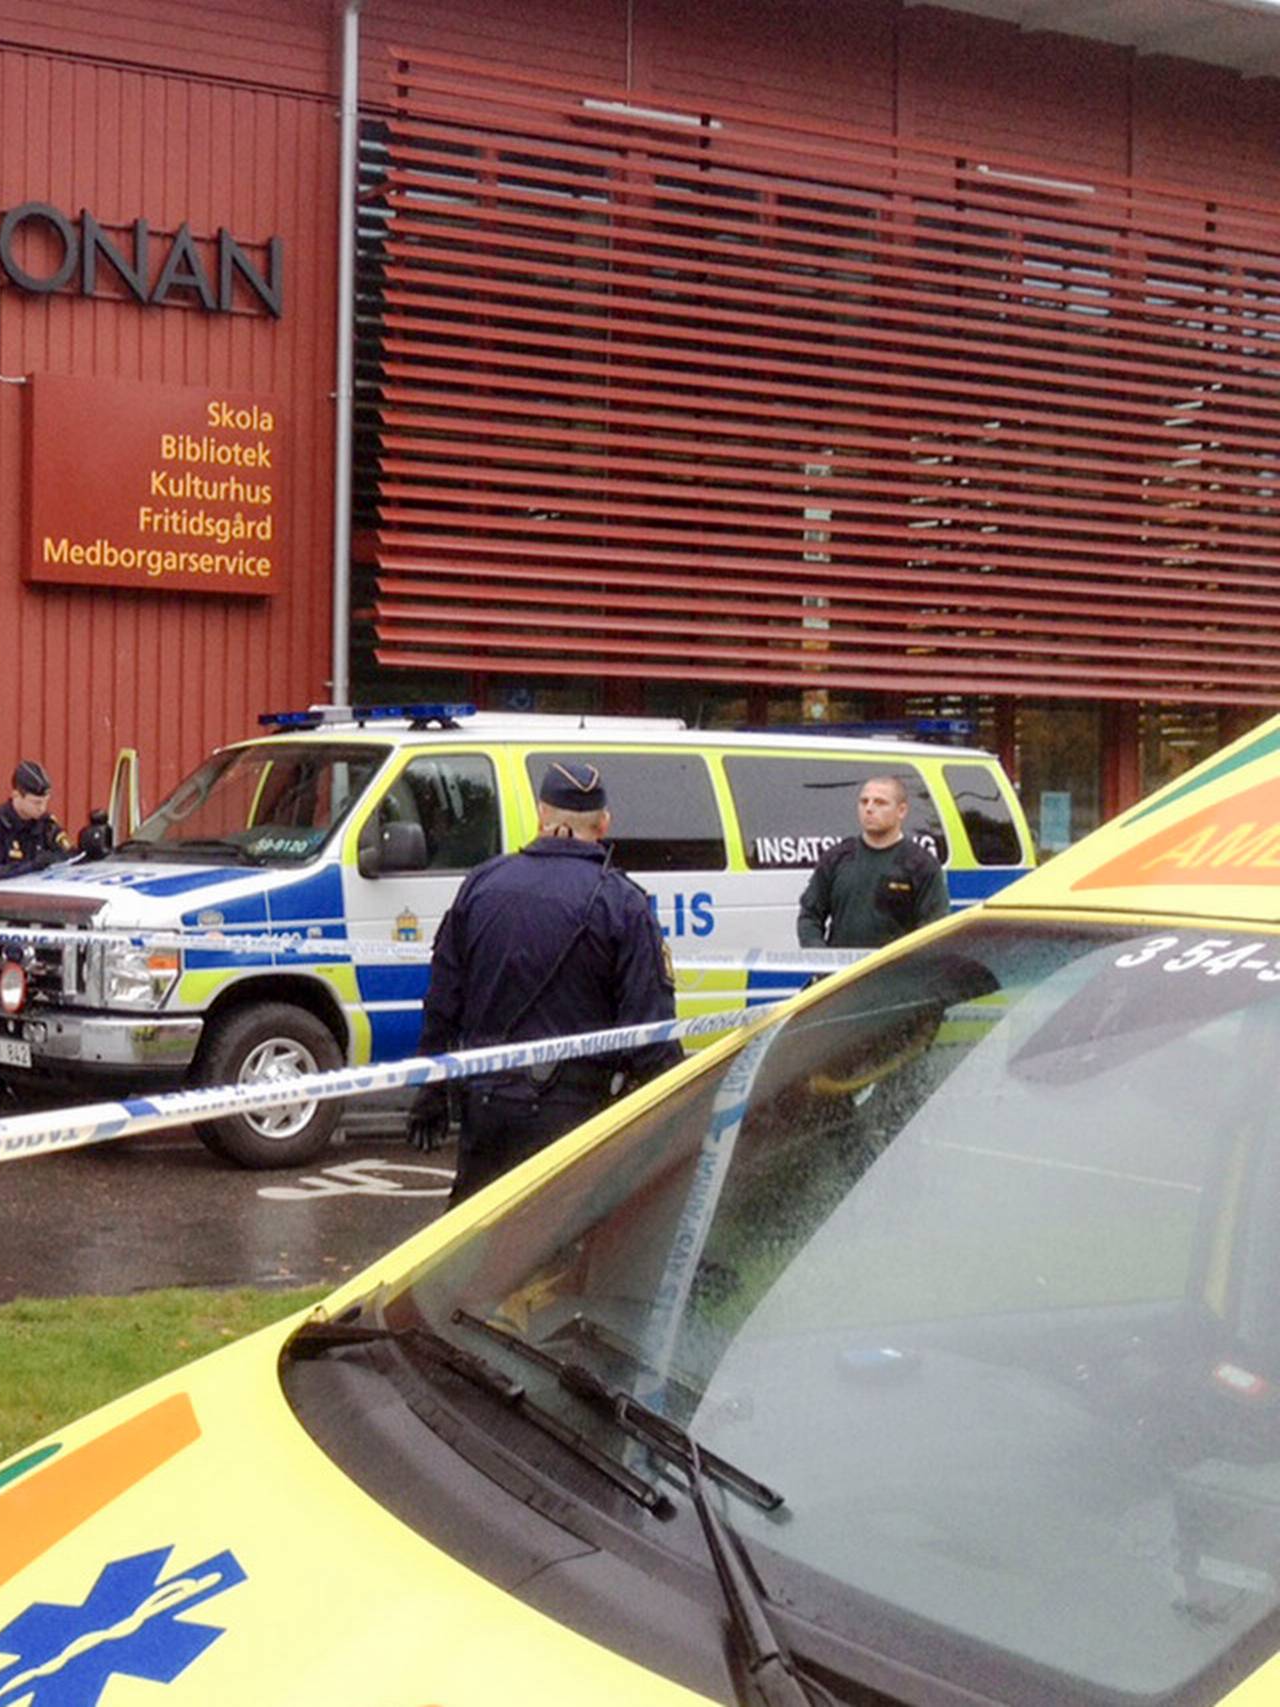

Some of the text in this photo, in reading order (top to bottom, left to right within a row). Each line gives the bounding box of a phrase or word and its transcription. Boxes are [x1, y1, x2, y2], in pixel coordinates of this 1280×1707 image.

[208, 402, 273, 431] Skola
[161, 434, 272, 468] Bibliotek
[150, 470, 272, 504] Kulturhus
[138, 507, 272, 544] Fritidsgård
[42, 537, 271, 577] Medborgarservice
